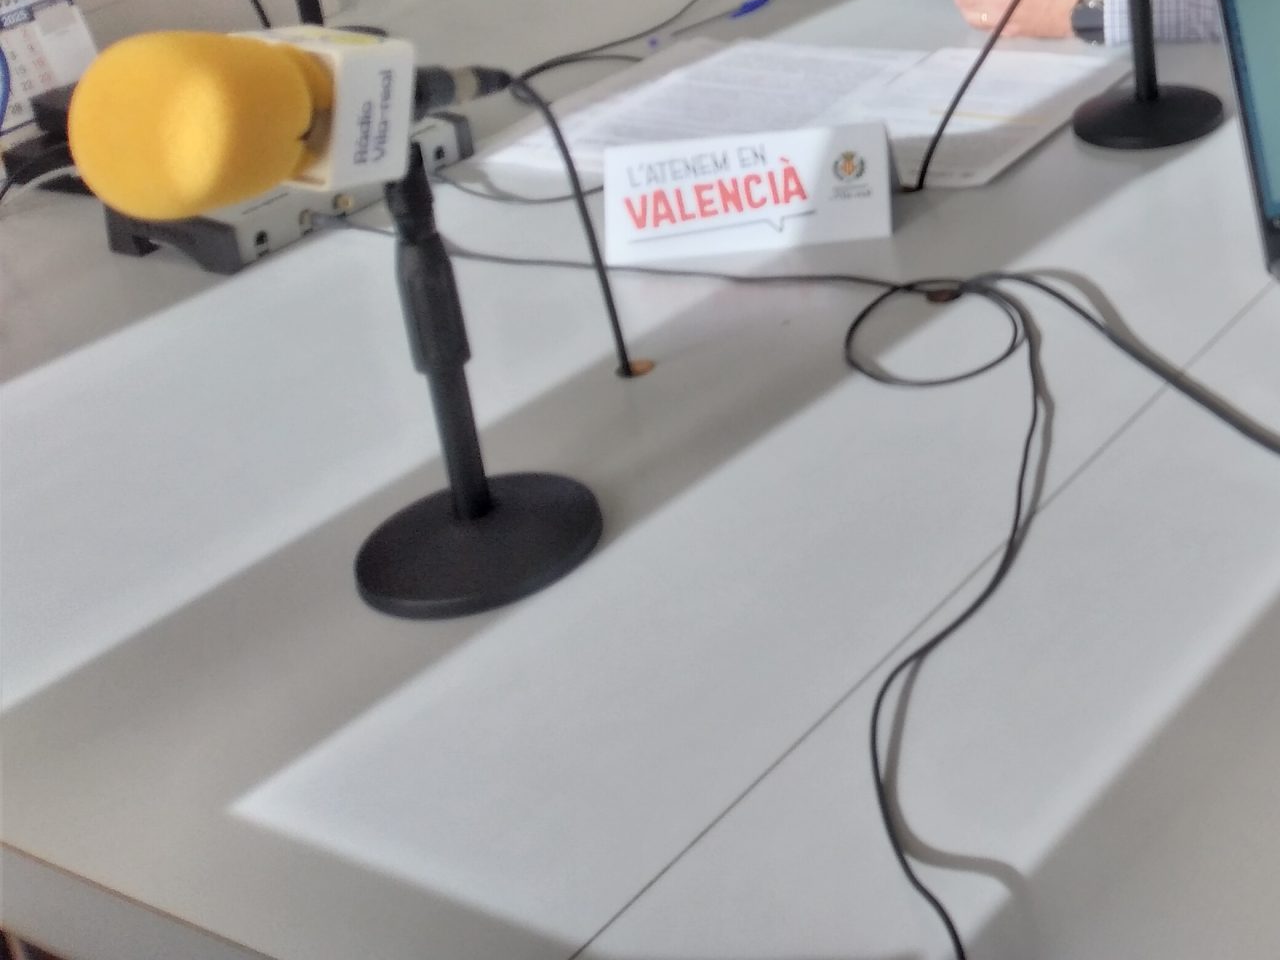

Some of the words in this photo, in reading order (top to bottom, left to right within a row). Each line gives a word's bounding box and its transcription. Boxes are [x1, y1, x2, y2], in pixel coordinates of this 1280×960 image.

[624, 156, 808, 230] VALENCIÀ
[627, 150, 731, 188] L'ATENEM
[737, 143, 768, 170] EN
